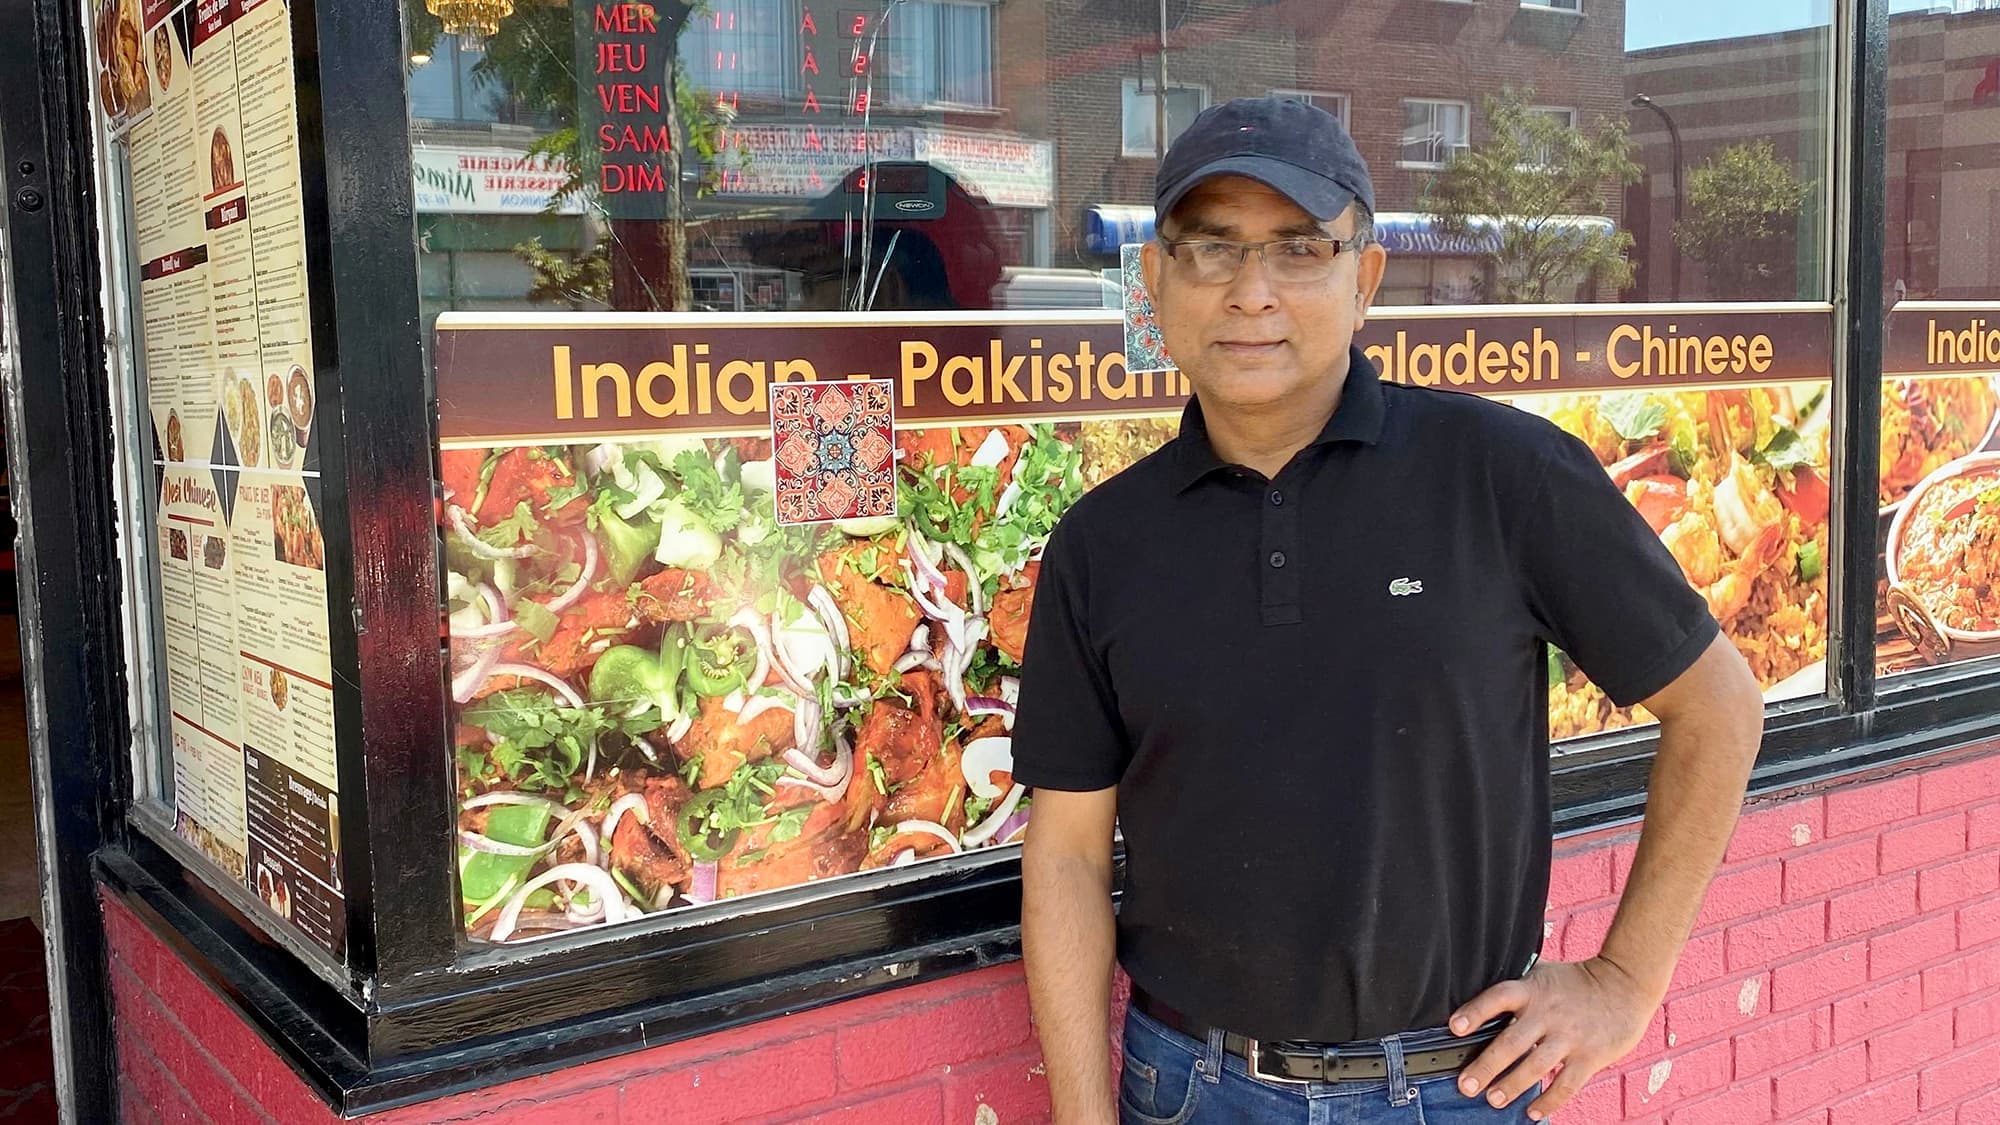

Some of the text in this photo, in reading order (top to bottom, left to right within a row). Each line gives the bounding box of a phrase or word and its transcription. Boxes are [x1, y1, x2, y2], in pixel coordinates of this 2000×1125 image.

[594, 3, 656, 34] MER
[853, 16, 865, 34] 2
[596, 43, 646, 74] JEU
[854, 55, 867, 74] 2
[597, 84, 661, 113] VEN
[599, 124, 671, 153] SAM
[601, 164, 665, 193] DIM
[1606, 324, 1774, 379] Chinese
